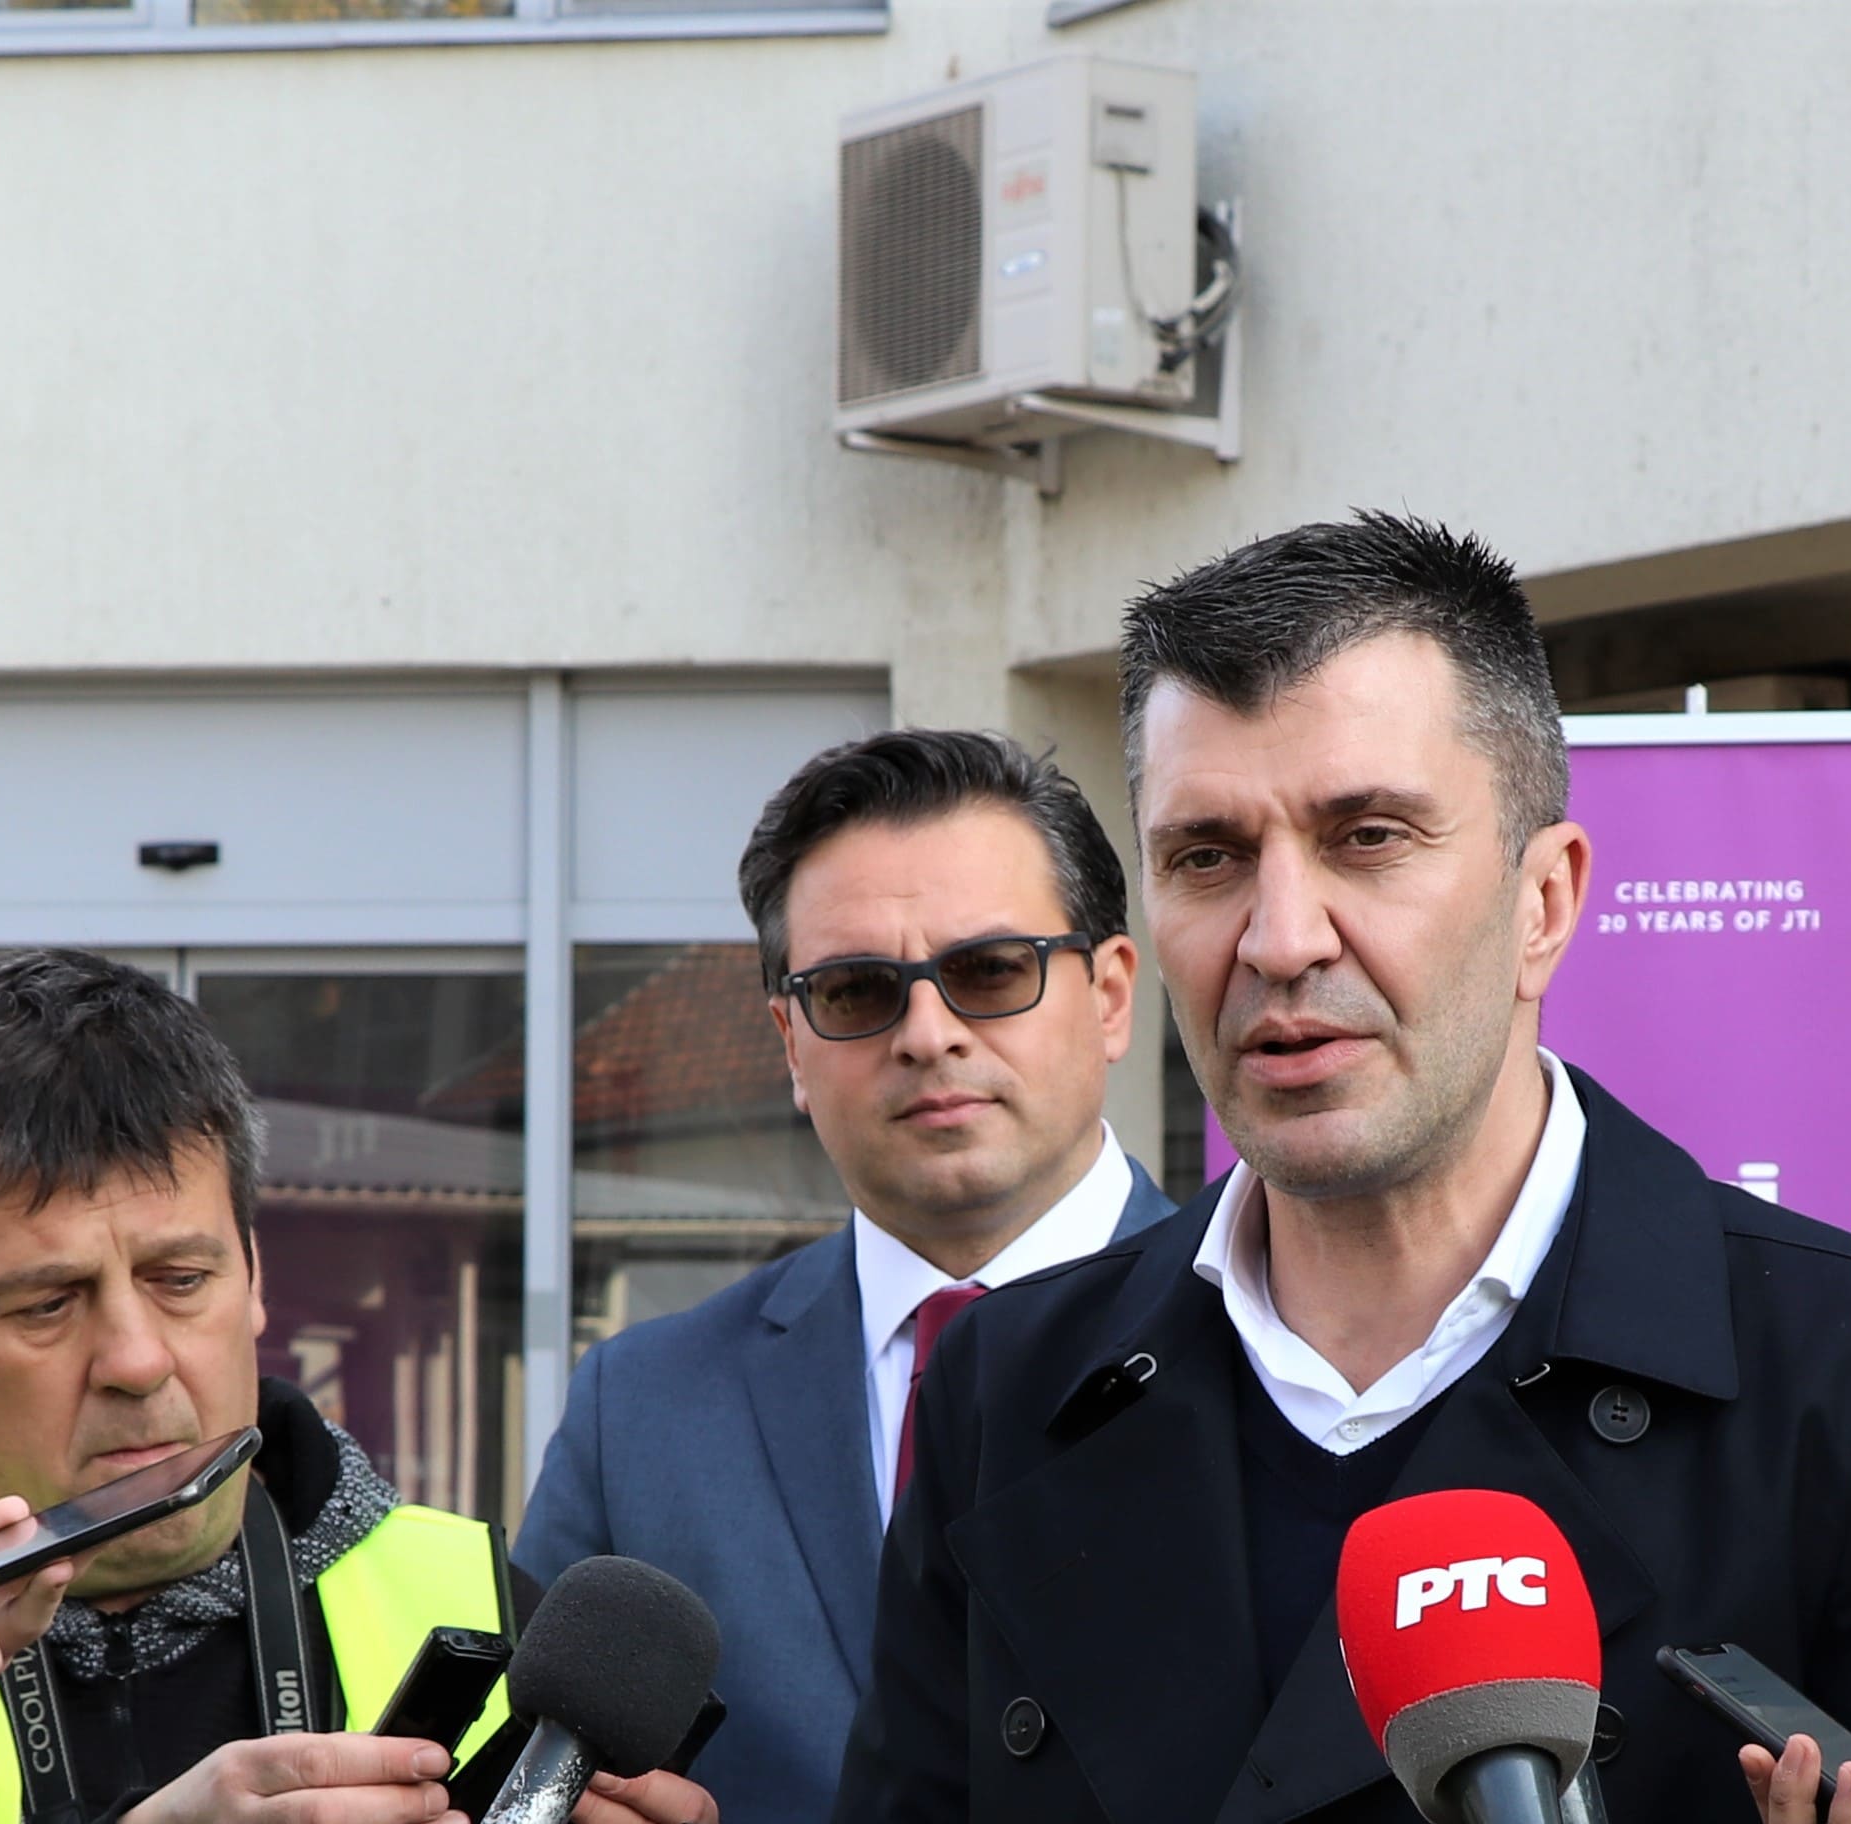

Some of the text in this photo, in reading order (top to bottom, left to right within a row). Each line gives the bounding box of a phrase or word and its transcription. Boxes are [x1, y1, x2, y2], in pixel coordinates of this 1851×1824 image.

[1615, 880, 1804, 903] CELEBRATING
[1598, 909, 1820, 933] 20 YEARS OF JTI
